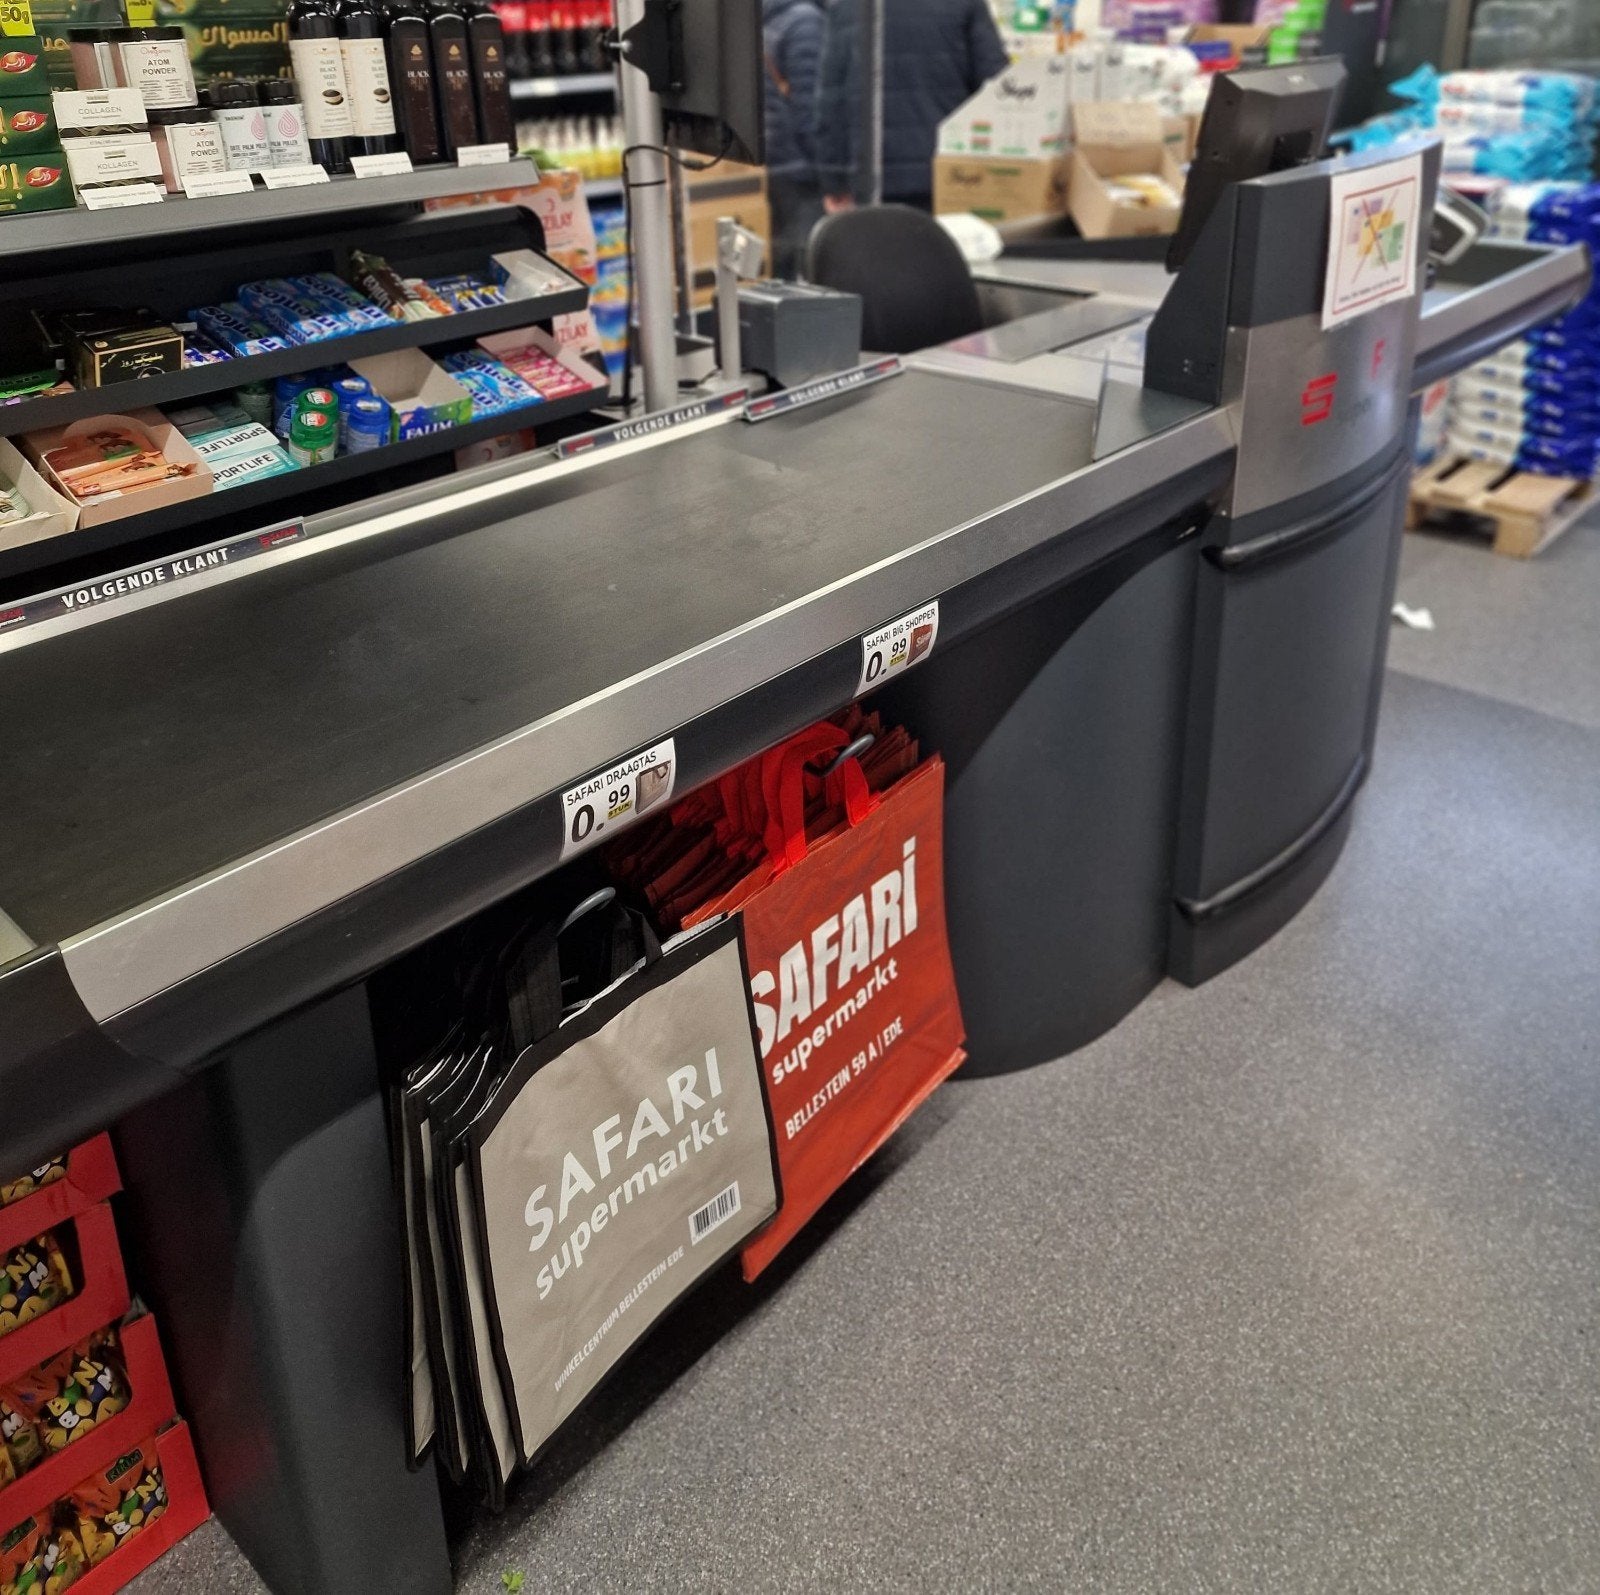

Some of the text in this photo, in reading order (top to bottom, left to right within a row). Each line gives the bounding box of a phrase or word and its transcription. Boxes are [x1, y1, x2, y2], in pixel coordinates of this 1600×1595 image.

[142, 67, 177, 75] POWDER
[148, 59, 170, 67] ATOM
[78, 106, 122, 116] COLLAGEN
[190, 148, 220, 158] POWDER
[196, 140, 215, 149] ATOM
[97, 160, 139, 170] KOLLAGEN
[406, 420, 453, 440] FALIM
[613, 404, 707, 441] VOLGENDE KLANT
[198, 426, 267, 454] SPORTLIFE
[213, 454, 275, 483] PORTLIFE
[61, 547, 229, 608] VOLGENDE KLANT
[866, 608, 936, 651] SAFARI BIG SHOPPER
[891, 637, 907, 658] 99
[567, 751, 657, 806] SAFARI DRAAGTAS
[607, 784, 631, 809] 99
[608, 801, 633, 817] STUK
[772, 957, 899, 1086] supermarkt
[785, 1065, 851, 1140] BELLESTEIN
[851, 1050, 867, 1077] 59
[868, 1042, 878, 1063] A
[883, 1016, 904, 1048] EDE
[524, 1046, 723, 1252] SAFARI
[536, 1108, 729, 1301] supermarkt
[554, 1245, 686, 1393] WINKELCENTRUM BELLESTEIN EDE
